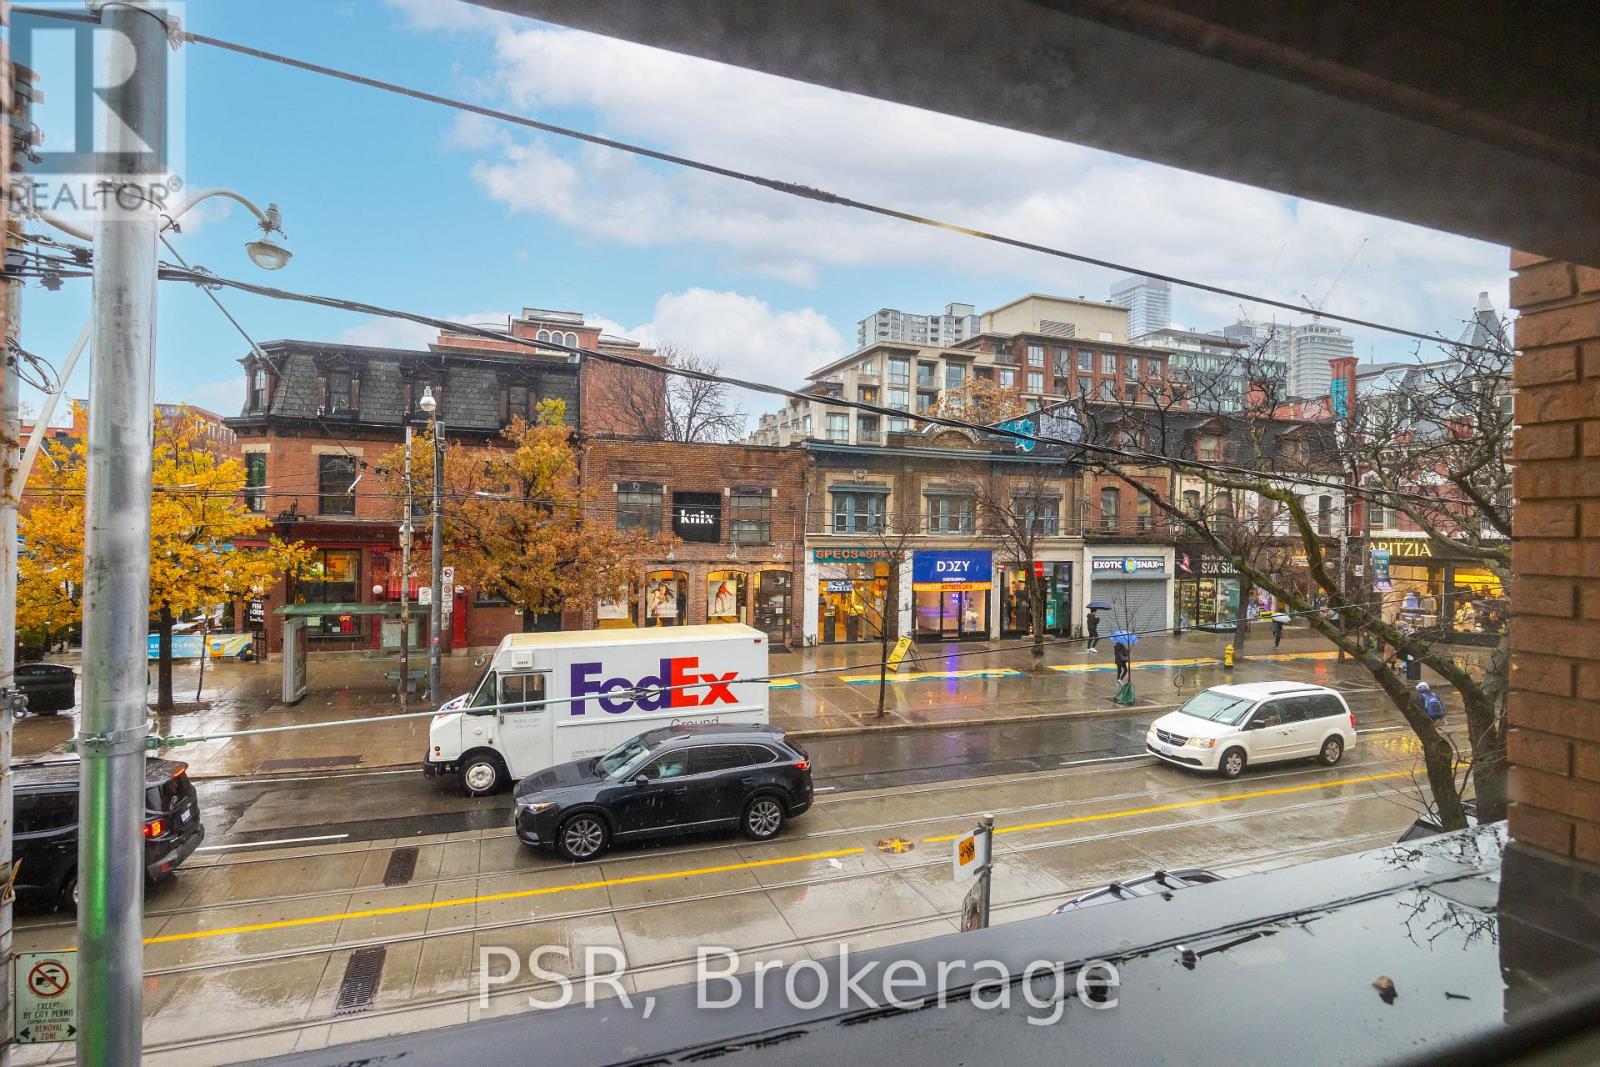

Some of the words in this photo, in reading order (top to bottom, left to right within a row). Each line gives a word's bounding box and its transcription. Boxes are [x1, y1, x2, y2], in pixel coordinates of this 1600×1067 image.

[680, 509, 714, 525] knix
[1093, 560, 1123, 569] EXOTIC
[1135, 559, 1158, 569] SNAX
[1201, 562, 1219, 574] SOX
[570, 656, 740, 716] FedEx
[23, 1011, 32, 1020] BY
[34, 1011, 49, 1019] CITY
[52, 1009, 74, 1017] PERMIT
[35, 1024, 62, 1032] REMOVAL
